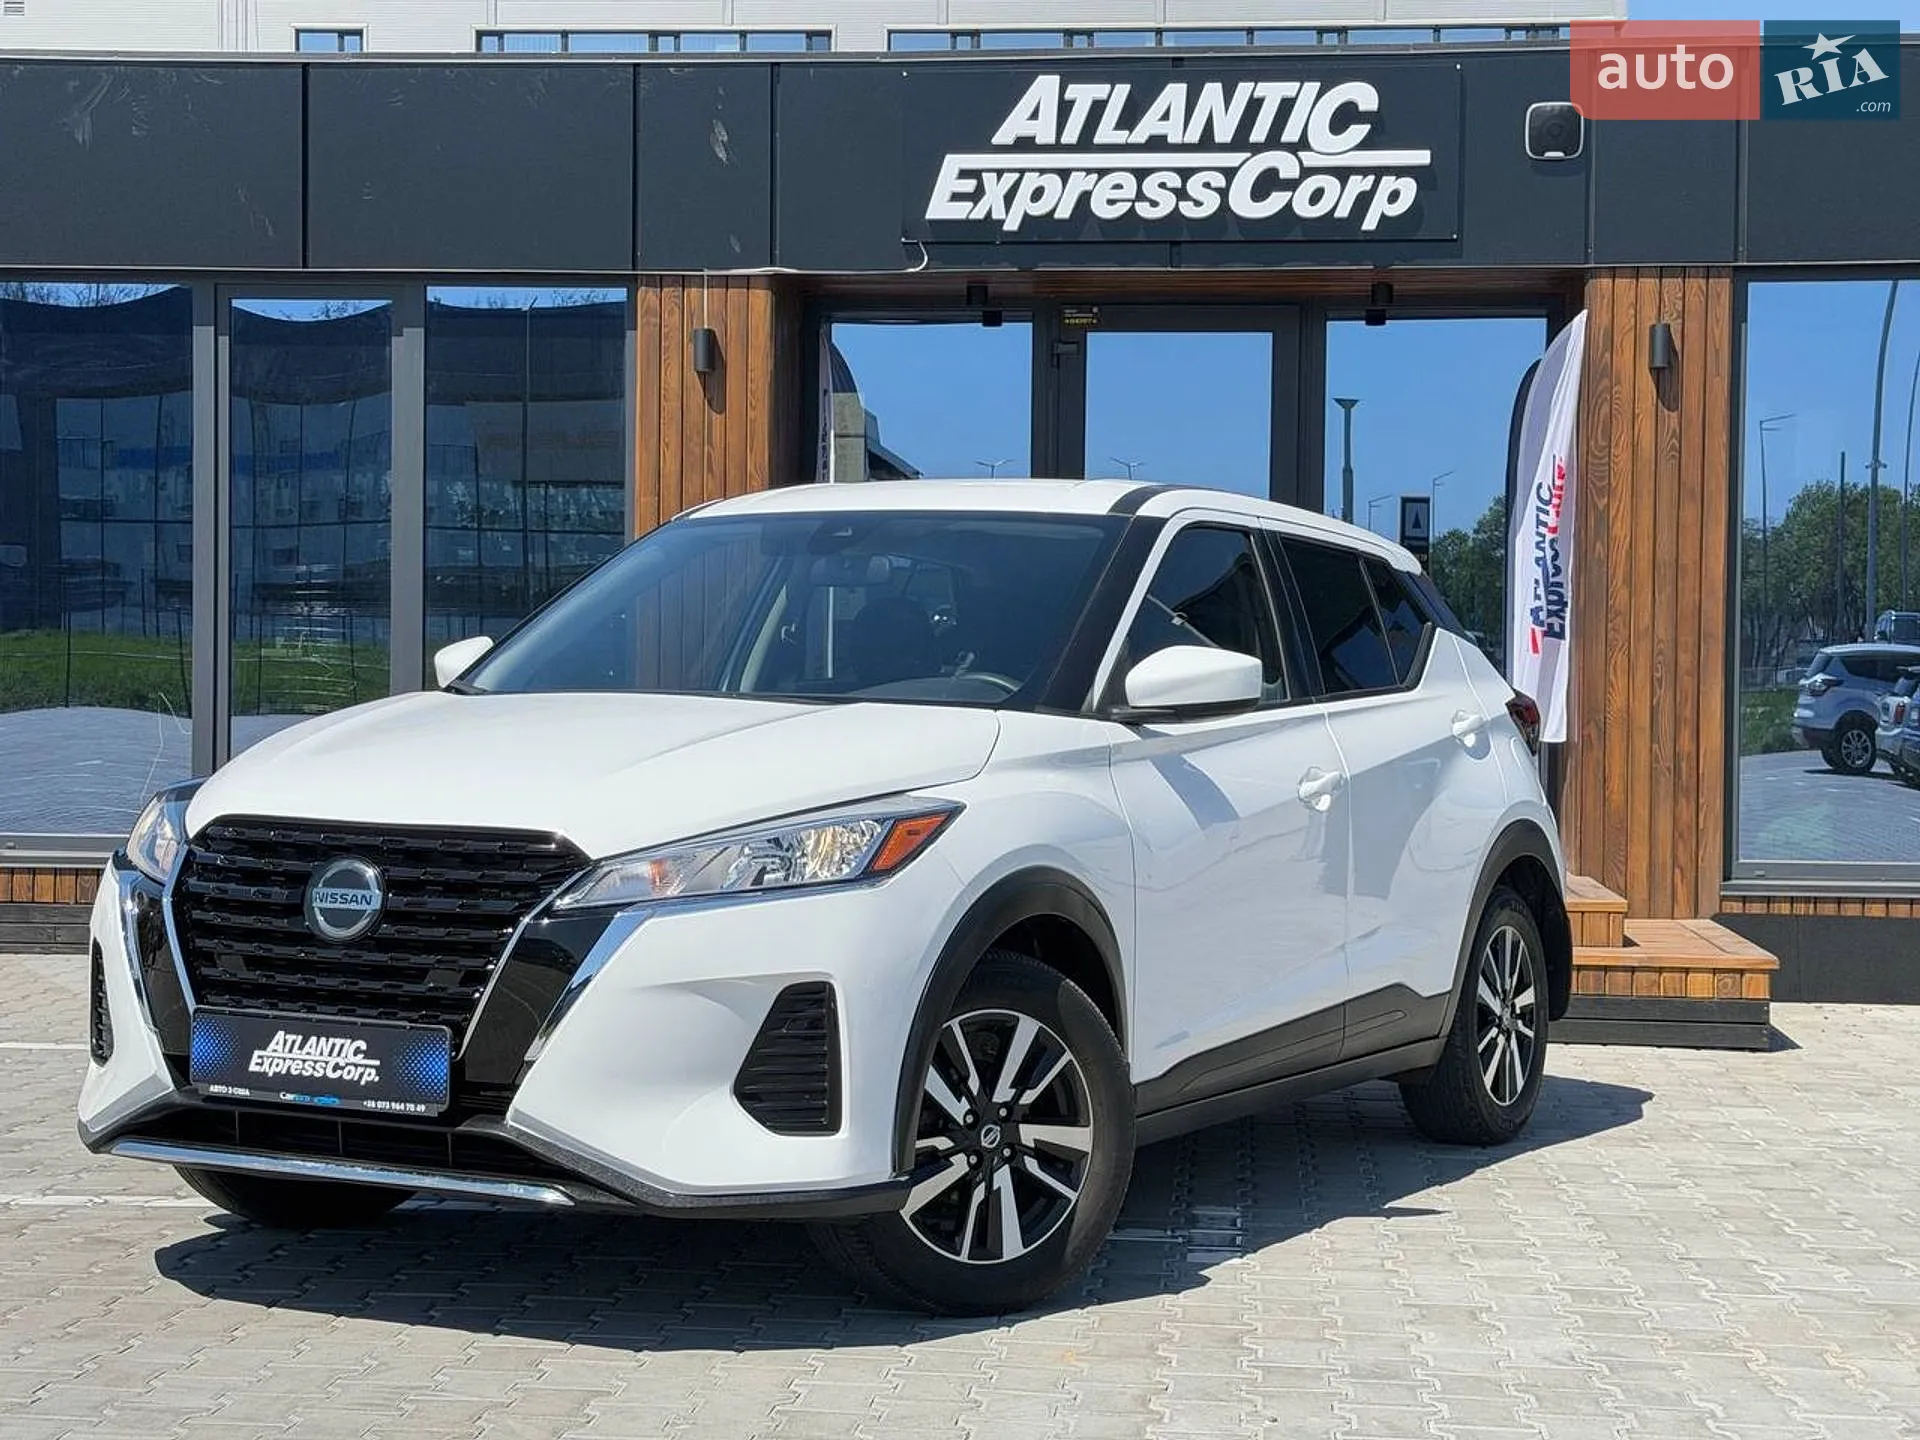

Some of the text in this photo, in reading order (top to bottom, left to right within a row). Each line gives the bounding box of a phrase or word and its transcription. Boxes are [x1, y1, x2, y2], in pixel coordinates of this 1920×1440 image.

[991, 74, 1380, 155] ATLANTIC
[925, 151, 1419, 232] ExpressCorp
[314, 891, 374, 906] NISSAN
[265, 1030, 368, 1061] ATLANTIC
[248, 1049, 381, 1086] ExpressCorp.
